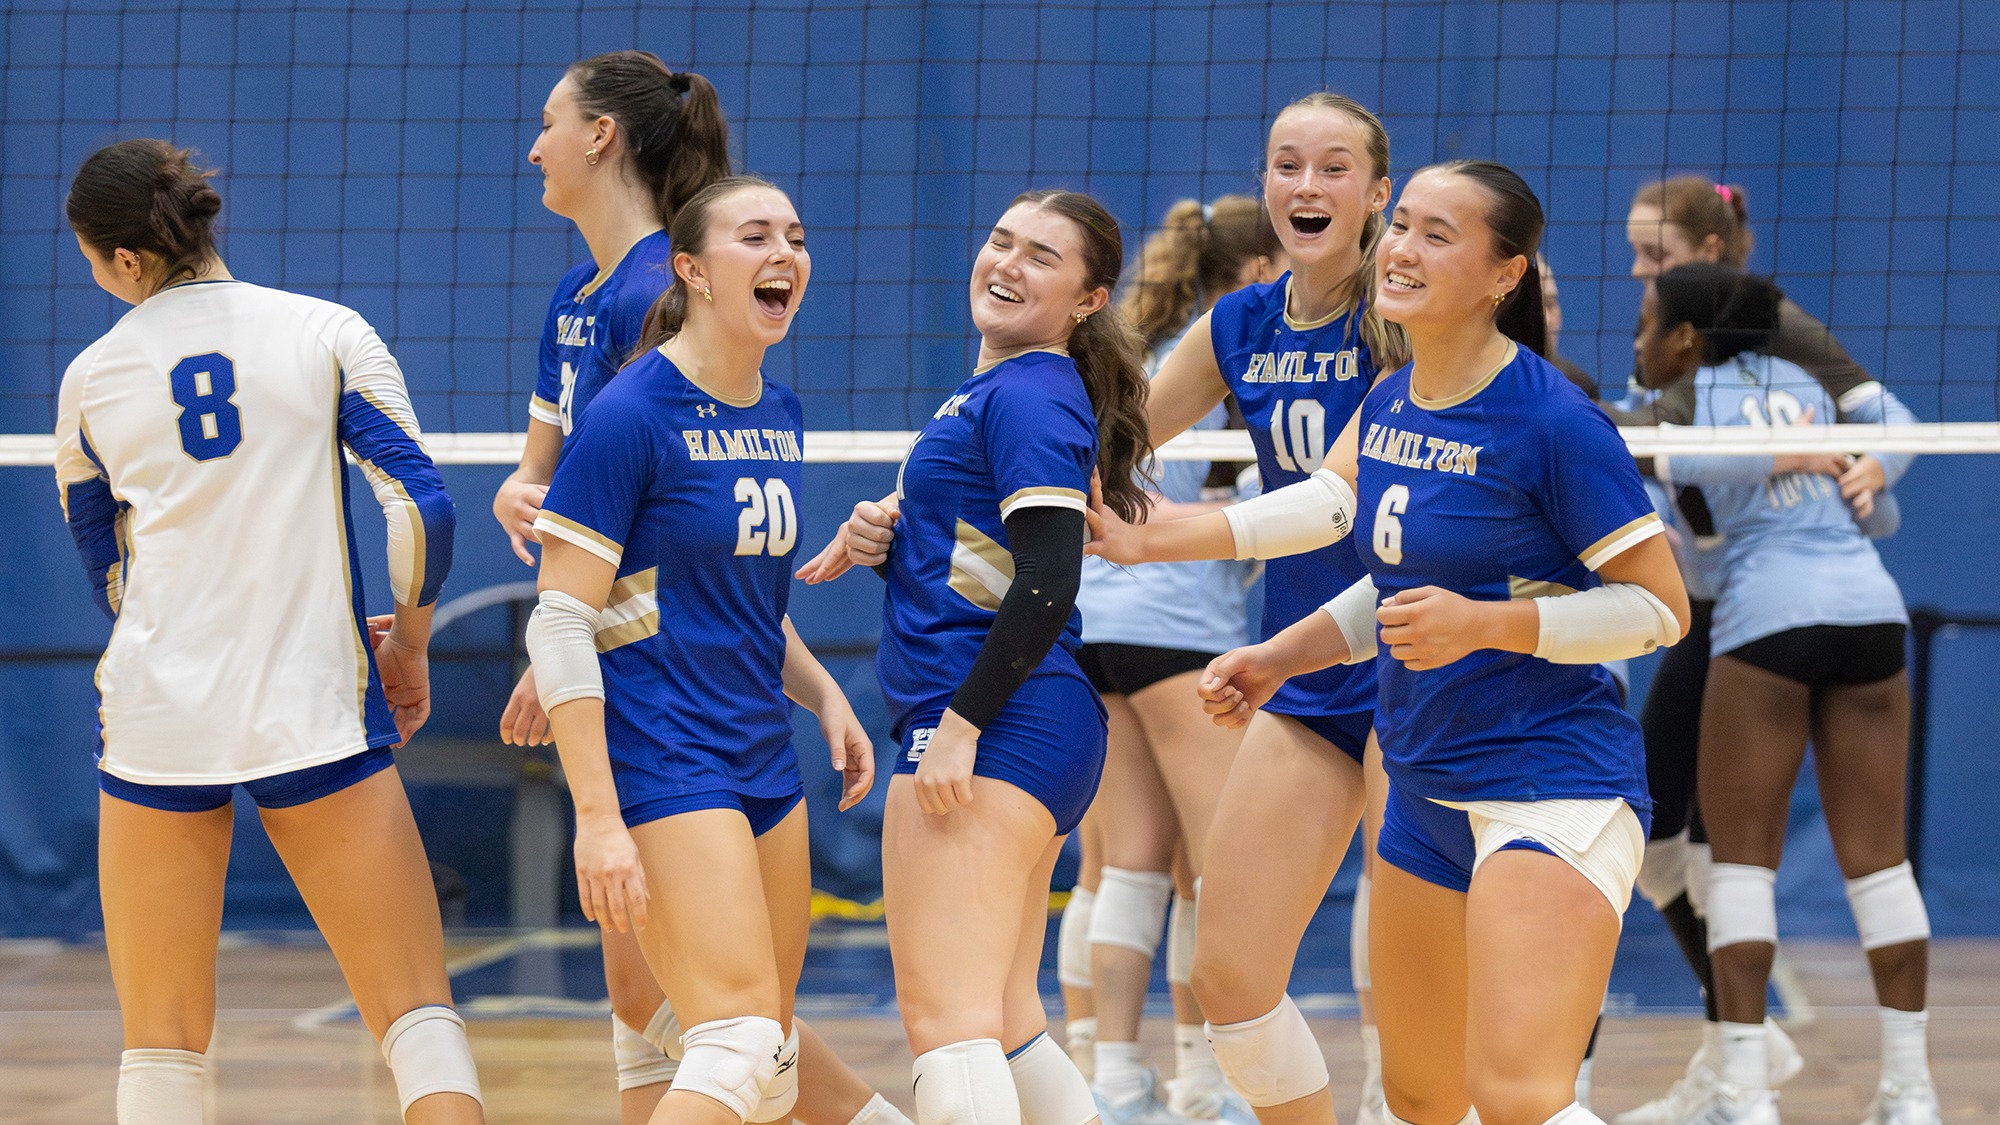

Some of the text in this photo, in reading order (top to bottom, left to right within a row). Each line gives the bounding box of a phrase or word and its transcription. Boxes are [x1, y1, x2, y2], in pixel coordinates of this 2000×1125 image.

[167, 350, 245, 464] 8
[682, 429, 802, 462] HAMILTON
[1270, 399, 1326, 475] 10
[1361, 423, 1484, 476] HAMILTON
[733, 477, 798, 556] 20
[1373, 483, 1410, 565] 6
